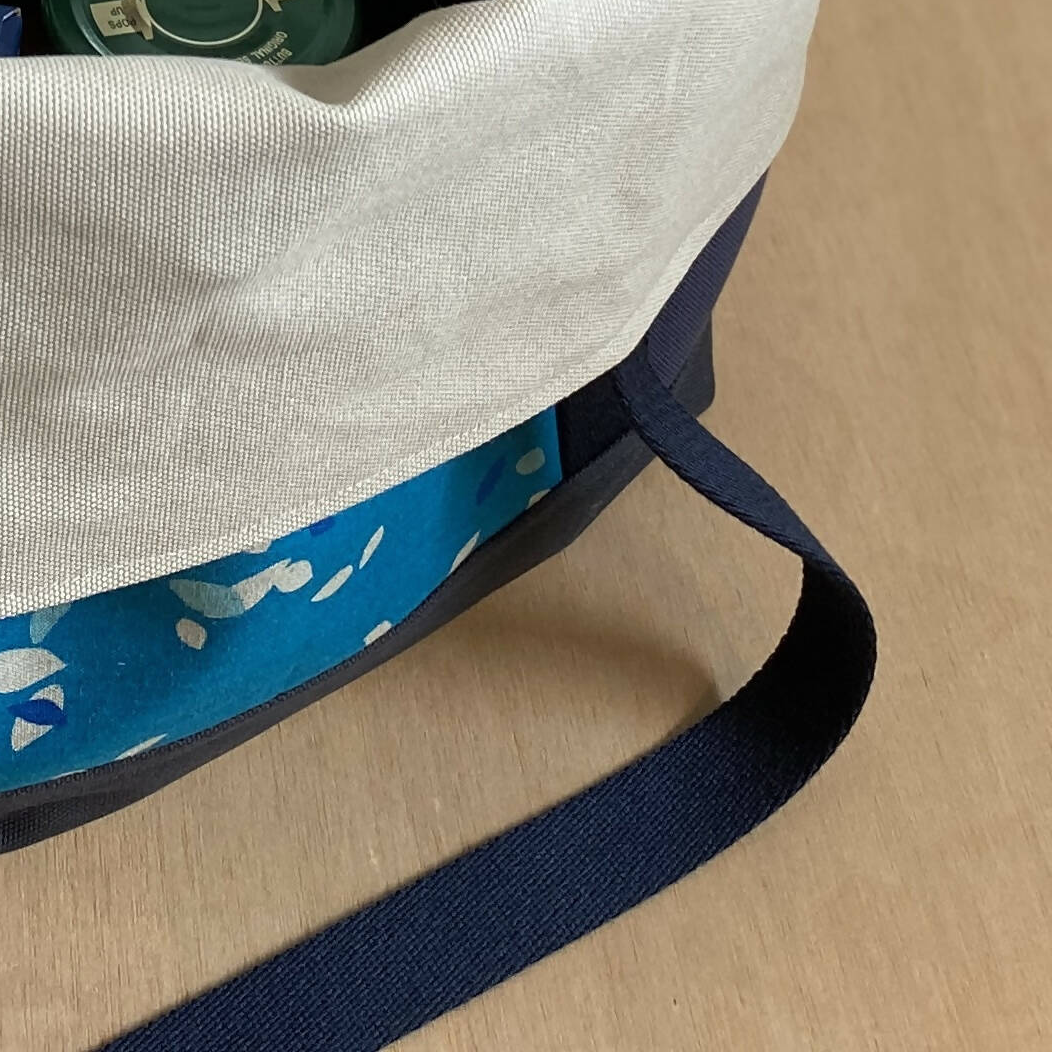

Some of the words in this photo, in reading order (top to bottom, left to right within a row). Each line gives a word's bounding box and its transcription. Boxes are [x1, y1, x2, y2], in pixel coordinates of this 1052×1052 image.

[110, 5, 124, 17] UP
[107, 18, 137, 30] POPS
[250, 31, 288, 60] ORIGINAL
